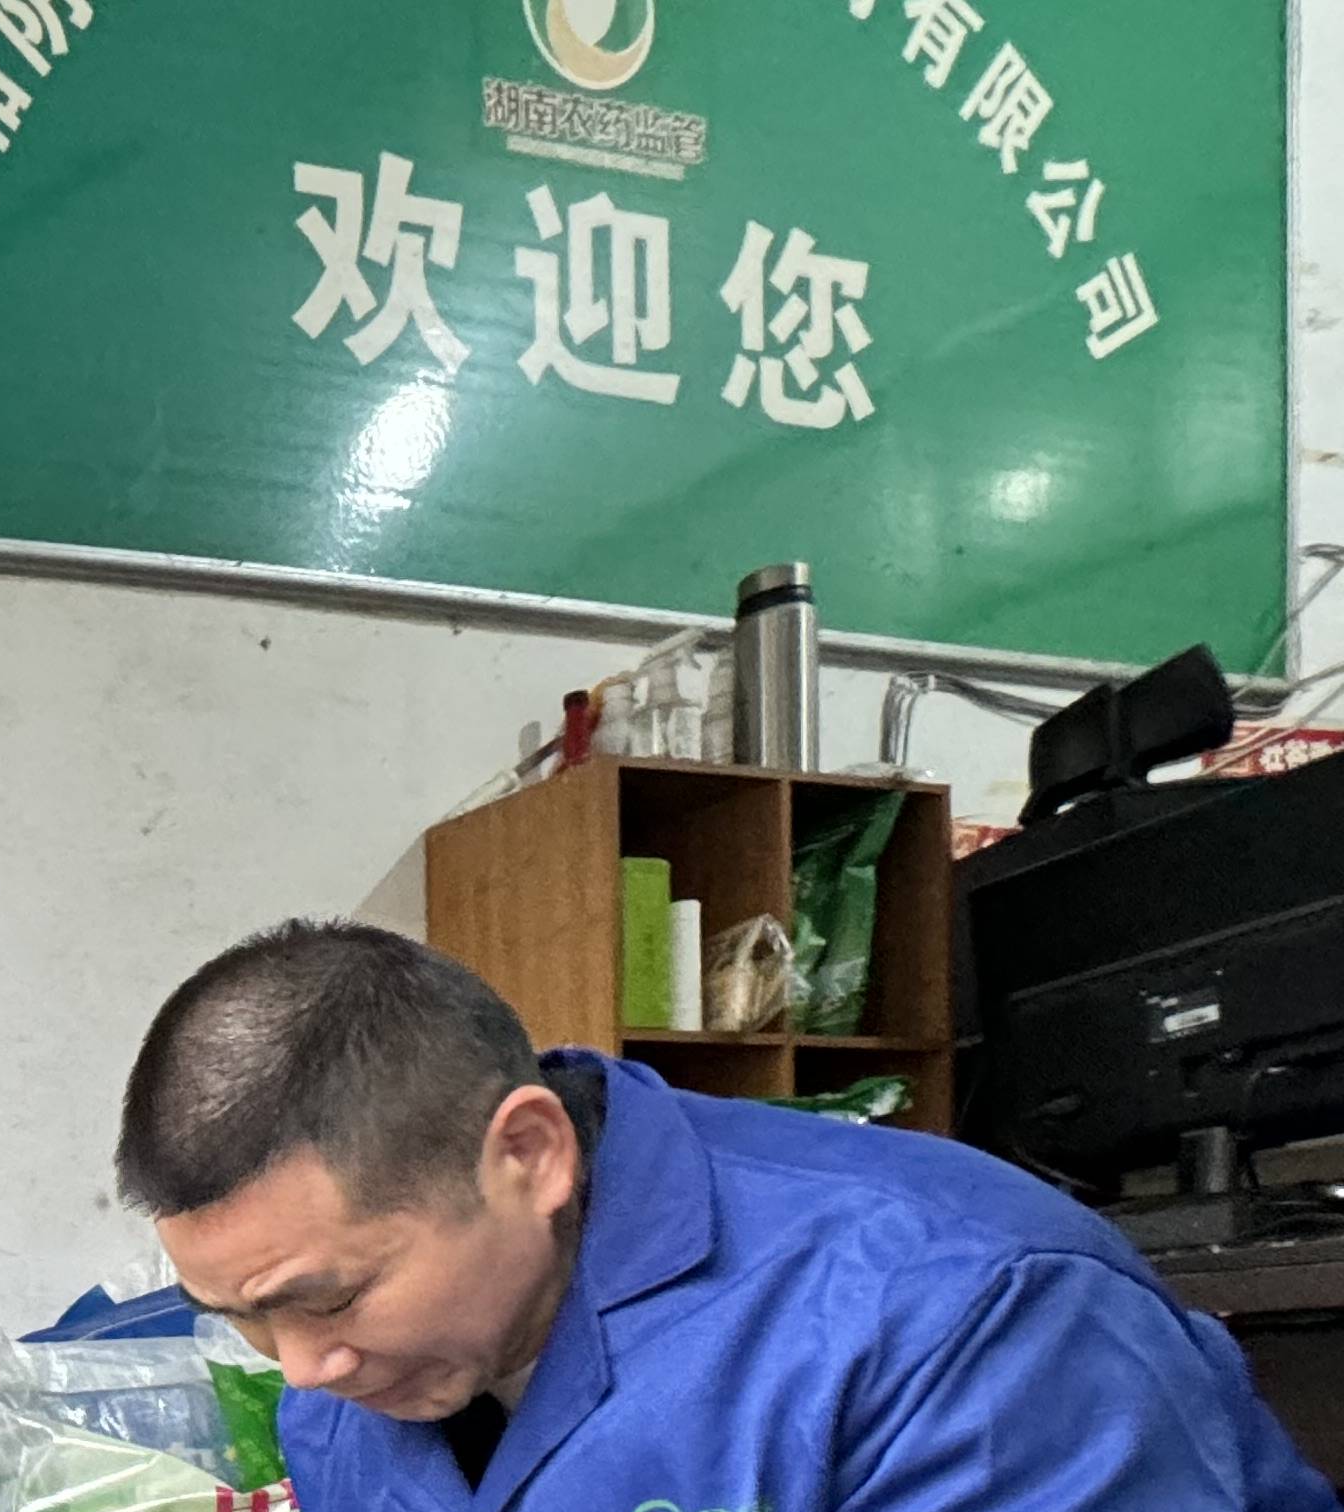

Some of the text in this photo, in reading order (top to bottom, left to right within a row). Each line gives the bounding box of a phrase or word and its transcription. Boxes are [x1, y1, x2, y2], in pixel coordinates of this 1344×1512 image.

[483, 76, 708, 163] 湖南农药监管
[292, 152, 877, 430] 欢迎您
